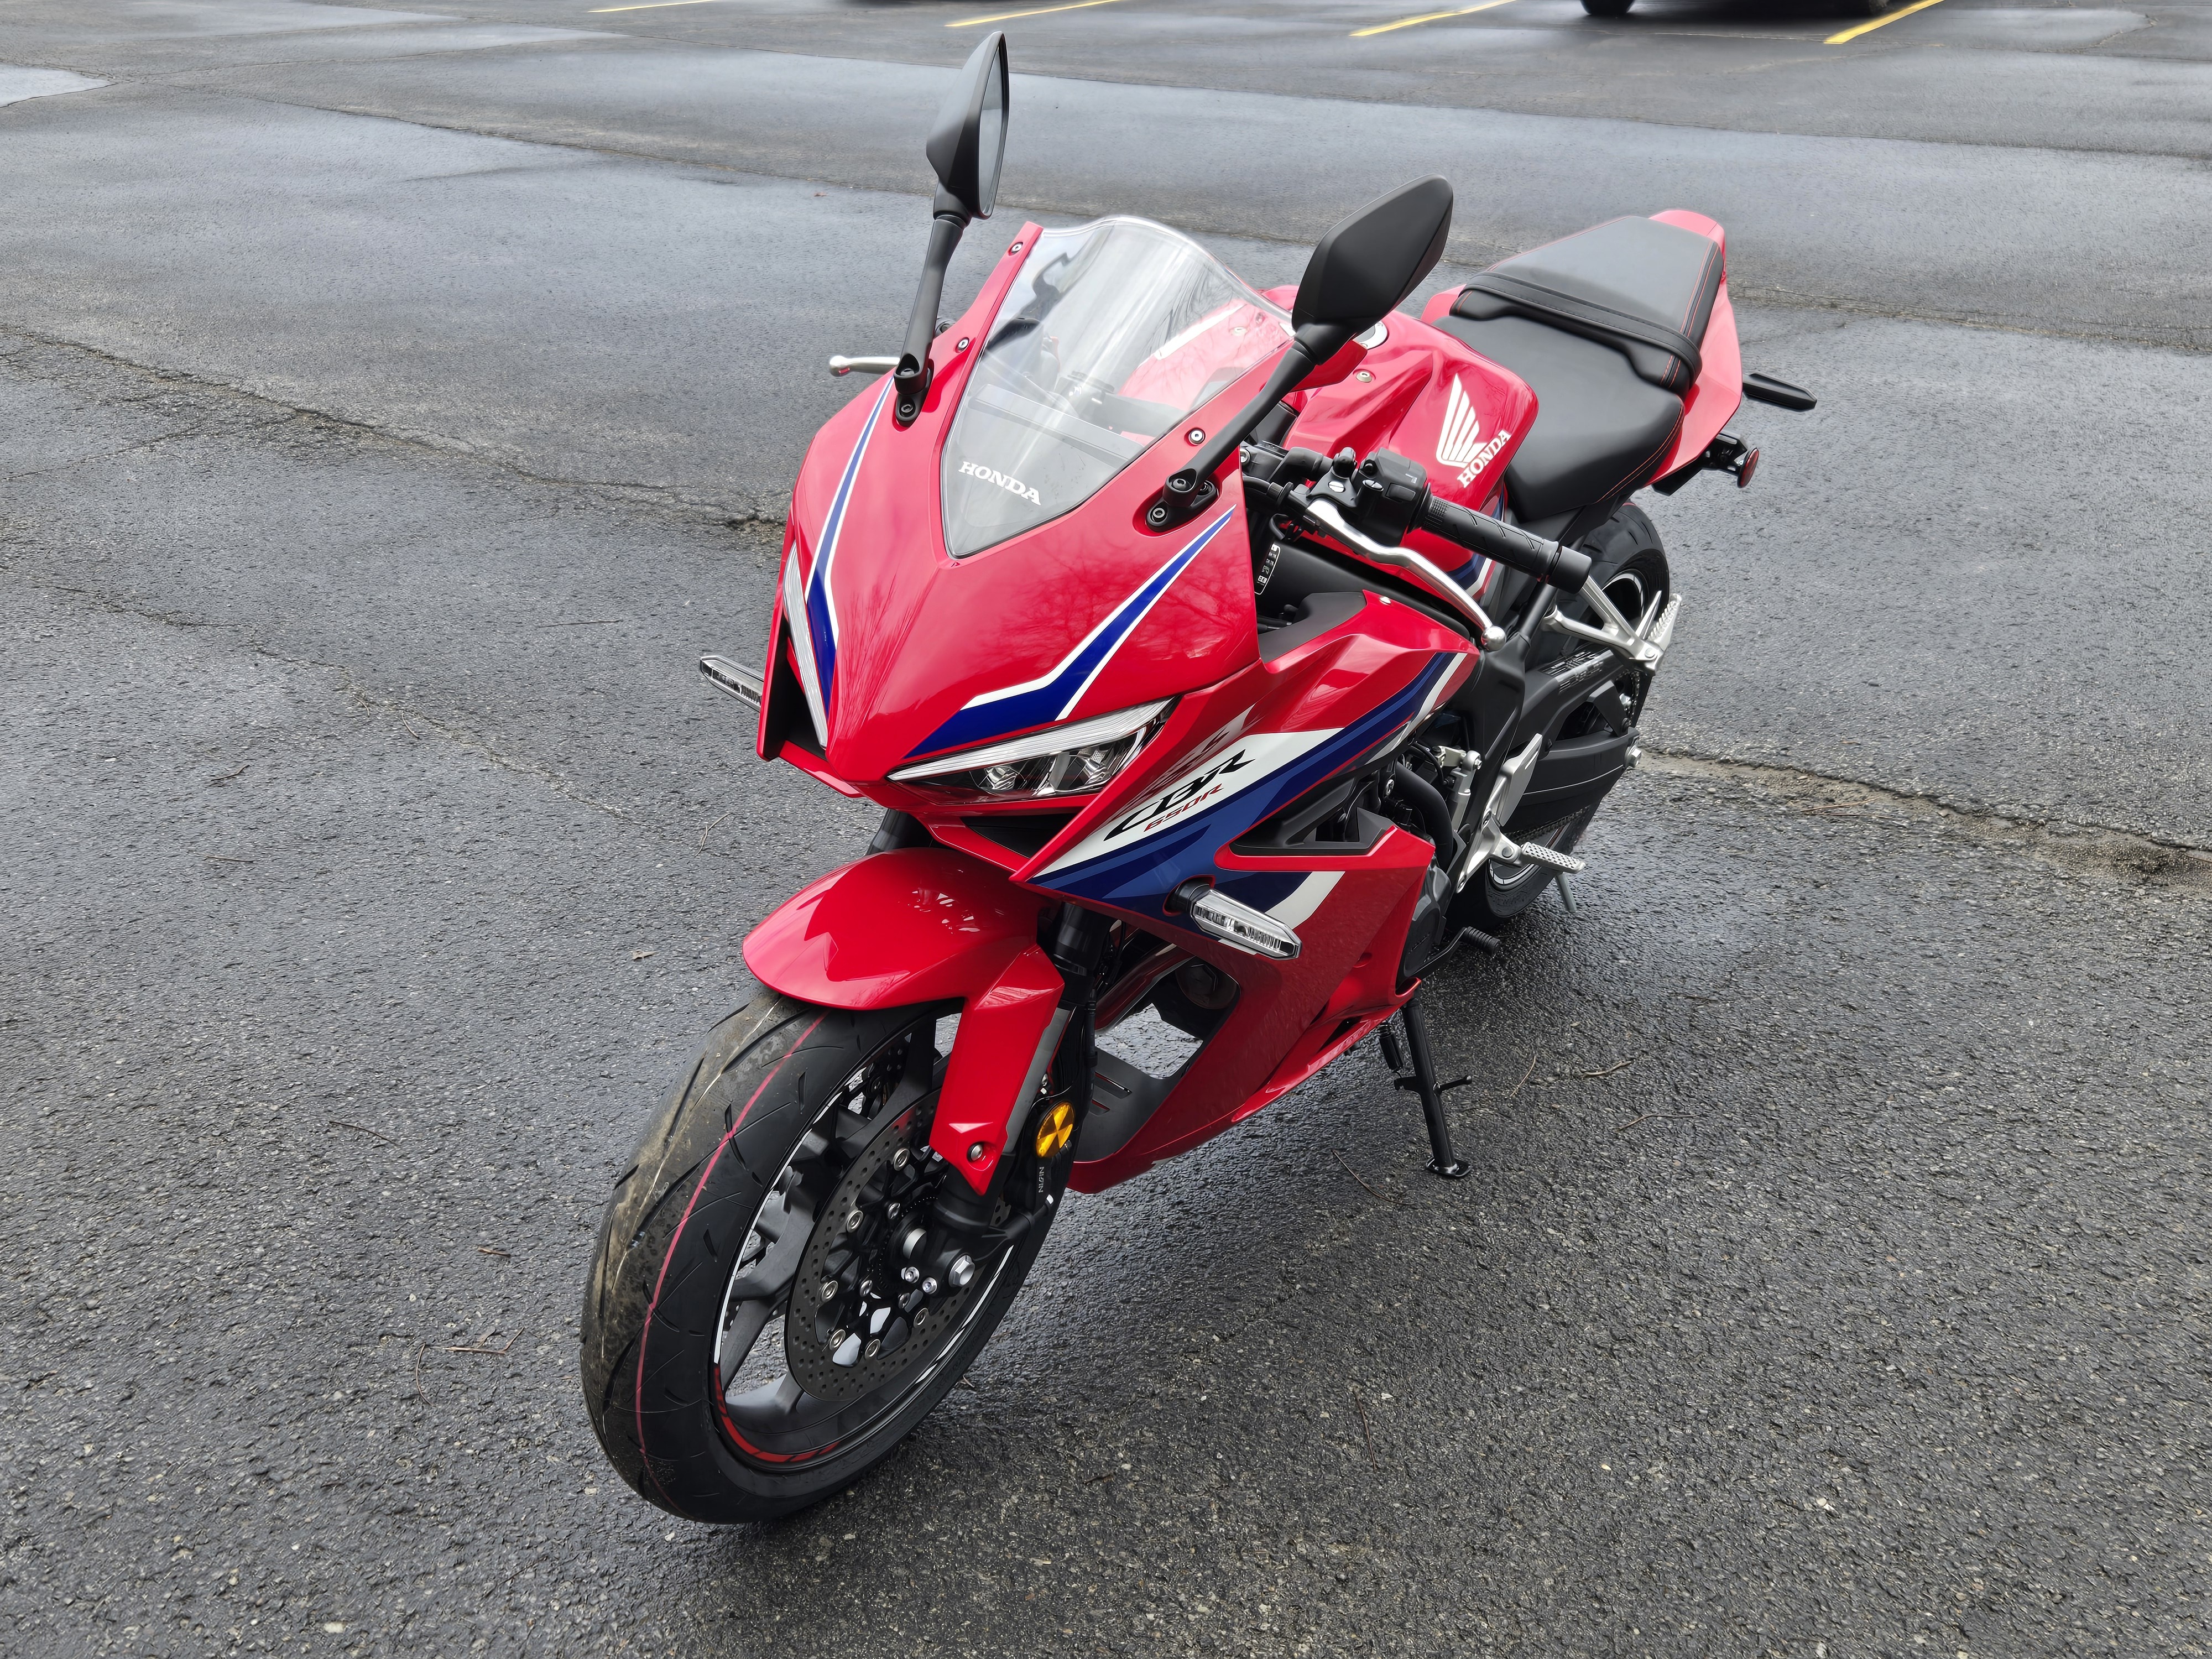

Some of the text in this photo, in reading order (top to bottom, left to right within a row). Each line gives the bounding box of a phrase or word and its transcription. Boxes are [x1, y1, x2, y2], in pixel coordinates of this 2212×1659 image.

[958, 461, 1041, 505] HONDA
[1457, 429, 1511, 488] HONDA
[1103, 749, 1255, 841] CBR
[1144, 783, 1224, 832] 650R
